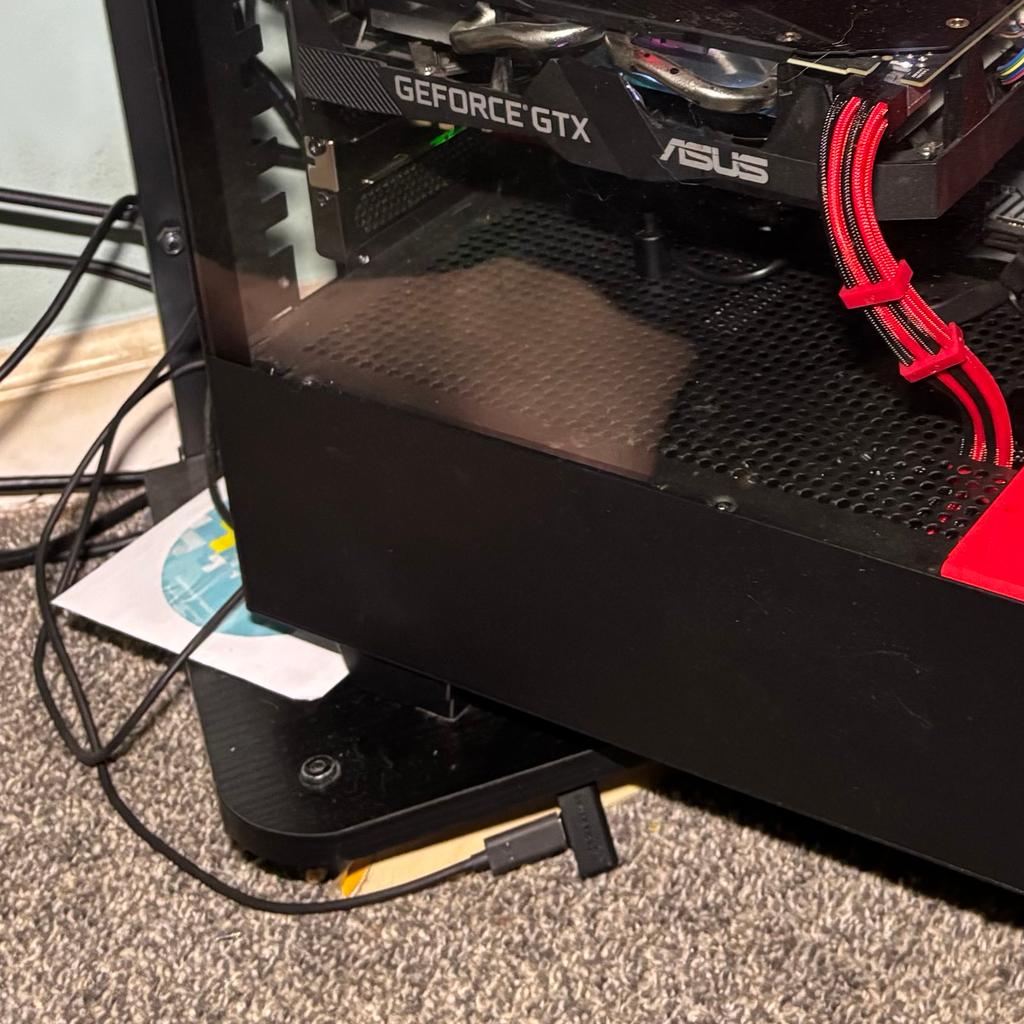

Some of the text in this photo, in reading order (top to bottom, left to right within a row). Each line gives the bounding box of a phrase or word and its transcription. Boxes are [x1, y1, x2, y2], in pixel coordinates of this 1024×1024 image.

[394, 74, 591, 144] GEFORCE GTX
[660, 137, 770, 184] ASUS
